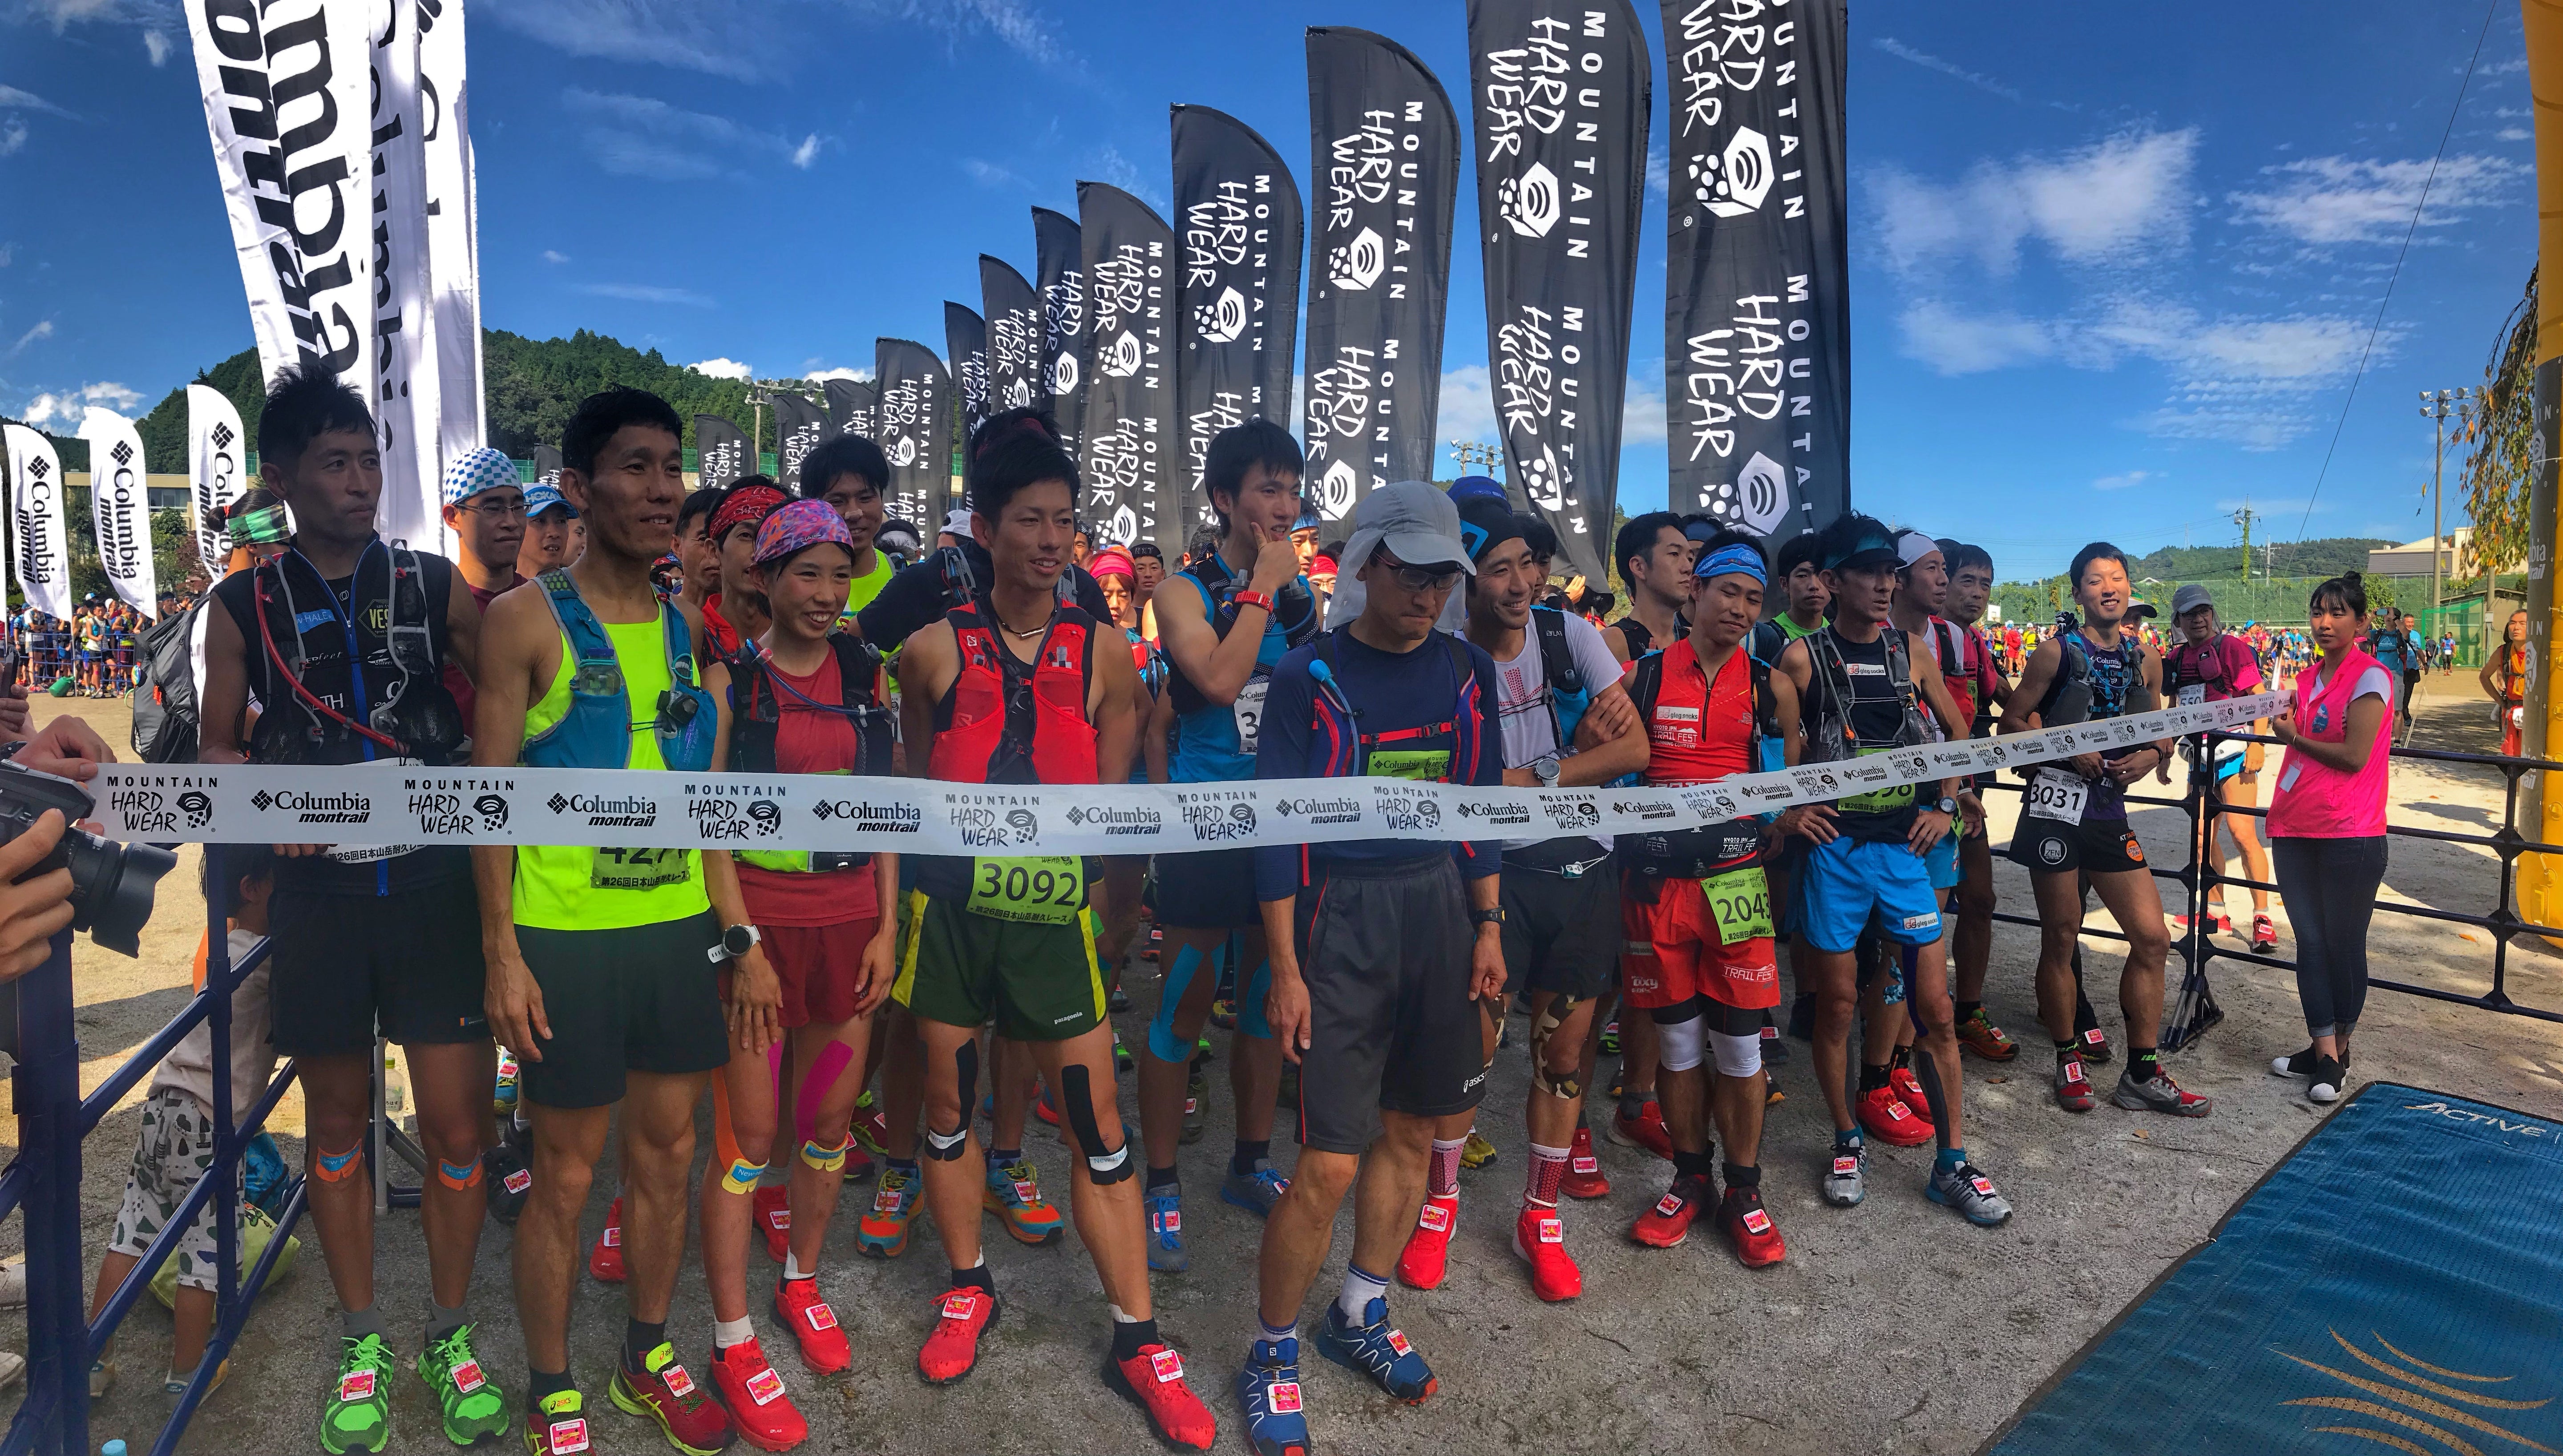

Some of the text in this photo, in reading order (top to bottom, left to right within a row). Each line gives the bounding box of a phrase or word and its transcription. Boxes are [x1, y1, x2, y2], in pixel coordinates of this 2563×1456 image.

[1524, 16, 1570, 134] HARD
[1680, 0, 1724, 137] WEAR
[1487, 48, 1529, 163] WEAR
[1567, 11, 1606, 258] MOUNTAIN
[1356, 109, 1395, 203] HARD
[1328, 134, 1362, 231] WEAR
[1389, 101, 1423, 299] MOUNTAIN
[1216, 181, 1249, 265] HARD
[1186, 202, 1217, 288] WEAR
[1253, 175, 1270, 351] MOUNTAIN
[1117, 244, 1144, 313] HARD
[1059, 271, 1083, 335] HARD
[1094, 262, 1119, 333] WEAR
[1044, 285, 1062, 351] WEAR
[1145, 241, 1162, 388] MOUNTAIN
[1009, 309, 1026, 364] HARD
[994, 319, 1014, 375] WEAR
[1520, 305, 1553, 418] HARD
[1733, 295, 1785, 419] HARD
[972, 351, 986, 402] HARD
[1498, 323, 1537, 440] WEAR
[960, 362, 978, 413] WEAR
[1332, 346, 1374, 438] HARD
[1687, 329, 1737, 461] WEAR
[898, 379, 918, 424] HARD
[883, 390, 901, 436] WEAR
[1308, 367, 1337, 461] WEAR
[1560, 306, 1587, 534] MOUNTAIN
[919, 374, 933, 470] MOUNTAIN
[716, 443, 730, 477] HARD
[785, 436, 800, 476] WEAR
[1116, 418, 1139, 487] HARD
[705, 452, 717, 488] WEAR
[1091, 436, 1117, 506] WEAR
[525, 491, 557, 503] HOKA
[113, 468, 137, 580] Columbia
[31, 481, 51, 585] Columbia
[99, 497, 121, 579] montrail
[17, 508, 37, 585] montrail
[2096, 657, 2122, 665] Columbia
[2145, 719, 2163, 729] Columbia
[2196, 712, 2212, 721] Columbia
[1653, 731, 1698, 742] TRAIL FEST
[2086, 730, 2107, 739] Columbia
[2113, 727, 2125, 735] HARD
[2118, 734, 2129, 742] WEAR
[1970, 741, 2002, 750] MOUNTAIN
[2017, 740, 2043, 751] Columbia
[2050, 737, 2062, 746] HARD
[2055, 744, 2070, 754] WEAR
[1888, 750, 1923, 761] MOUNTAIN
[1940, 751, 1969, 764] Columbia
[1976, 750, 1992, 760] HARD
[2027, 746, 2044, 755] montrail
[1383, 760, 1419, 769] Columbia
[1892, 760, 1912, 771] HARD
[1951, 758, 1971, 767] montrail
[1982, 756, 2000, 767] WEAR
[1791, 767, 1831, 777] MOUNTAIN
[1851, 766, 1885, 779] Columbia
[1864, 773, 1887, 782] montrail
[1900, 767, 1920, 779] WEAR
[107, 776, 218, 787] MOUNTAIN
[405, 779, 515, 791] MOUNTAIN
[684, 784, 786, 796] MOUNTAIN
[1750, 782, 1791, 796] Columbia
[1796, 776, 1817, 788] HARD
[1177, 791, 1257, 803] MOUNTAIN
[1374, 786, 1439, 799] MOUNTAIN
[1539, 794, 1595, 802] MOUNTAIN
[1680, 788, 1729, 800] MOUNTAIN
[1765, 791, 1793, 800] montrail
[1805, 784, 1829, 797] WEAR
[2030, 784, 2080, 811] 3031
[111, 791, 163, 812] HARD
[275, 790, 371, 811] Columbia
[408, 794, 461, 815] HARD
[570, 794, 657, 815] Columbia
[946, 794, 1040, 806] MOUNTAIN
[1293, 798, 1361, 815] Columbia
[1377, 799, 1411, 815] HARD
[1624, 801, 1673, 814] Columbia
[1686, 799, 1712, 811] HARD
[299, 811, 370, 823] montrail
[688, 799, 738, 820] HARD
[834, 801, 921, 820] Columbia
[950, 807, 995, 828] HARD
[1086, 807, 1161, 824] Columbia
[1183, 806, 1223, 824] HARD
[1471, 803, 1528, 817] Columbia
[1544, 804, 1574, 818] HARD
[1642, 810, 1676, 819] montrail
[1698, 806, 1725, 819] WEAR
[124, 811, 177, 832] WEAR
[421, 814, 474, 835] WEAR
[588, 815, 657, 827] montrail
[857, 820, 921, 833] montrail
[1310, 813, 1361, 825] montrail
[1387, 813, 1423, 831] WEAR
[1490, 815, 1530, 825] montrail
[1556, 815, 1587, 830] WEAR
[699, 819, 749, 840] WEAR
[962, 827, 1008, 847] WEAR
[1105, 824, 1161, 835] montrail
[1194, 823, 1238, 842] WEAR
[1646, 842, 1667, 852] FEST
[1723, 844, 1743, 853] TRAIL
[1041, 856, 1060, 865] WEAR
[977, 863, 1077, 906] 3092
[1715, 878, 1745, 887] Columbia
[974, 905, 1067, 923] 第26回日本山岳耐久レース
[1716, 892, 1771, 924] 2043
[1724, 966, 1775, 981] TRAIL FEST
[1468, 1072, 1486, 1089] asics
[2154, 1087, 2171, 1098] Columbia
[2408, 1102, 2547, 1137] ACTIVE
[556, 1396, 571, 1406] asics
